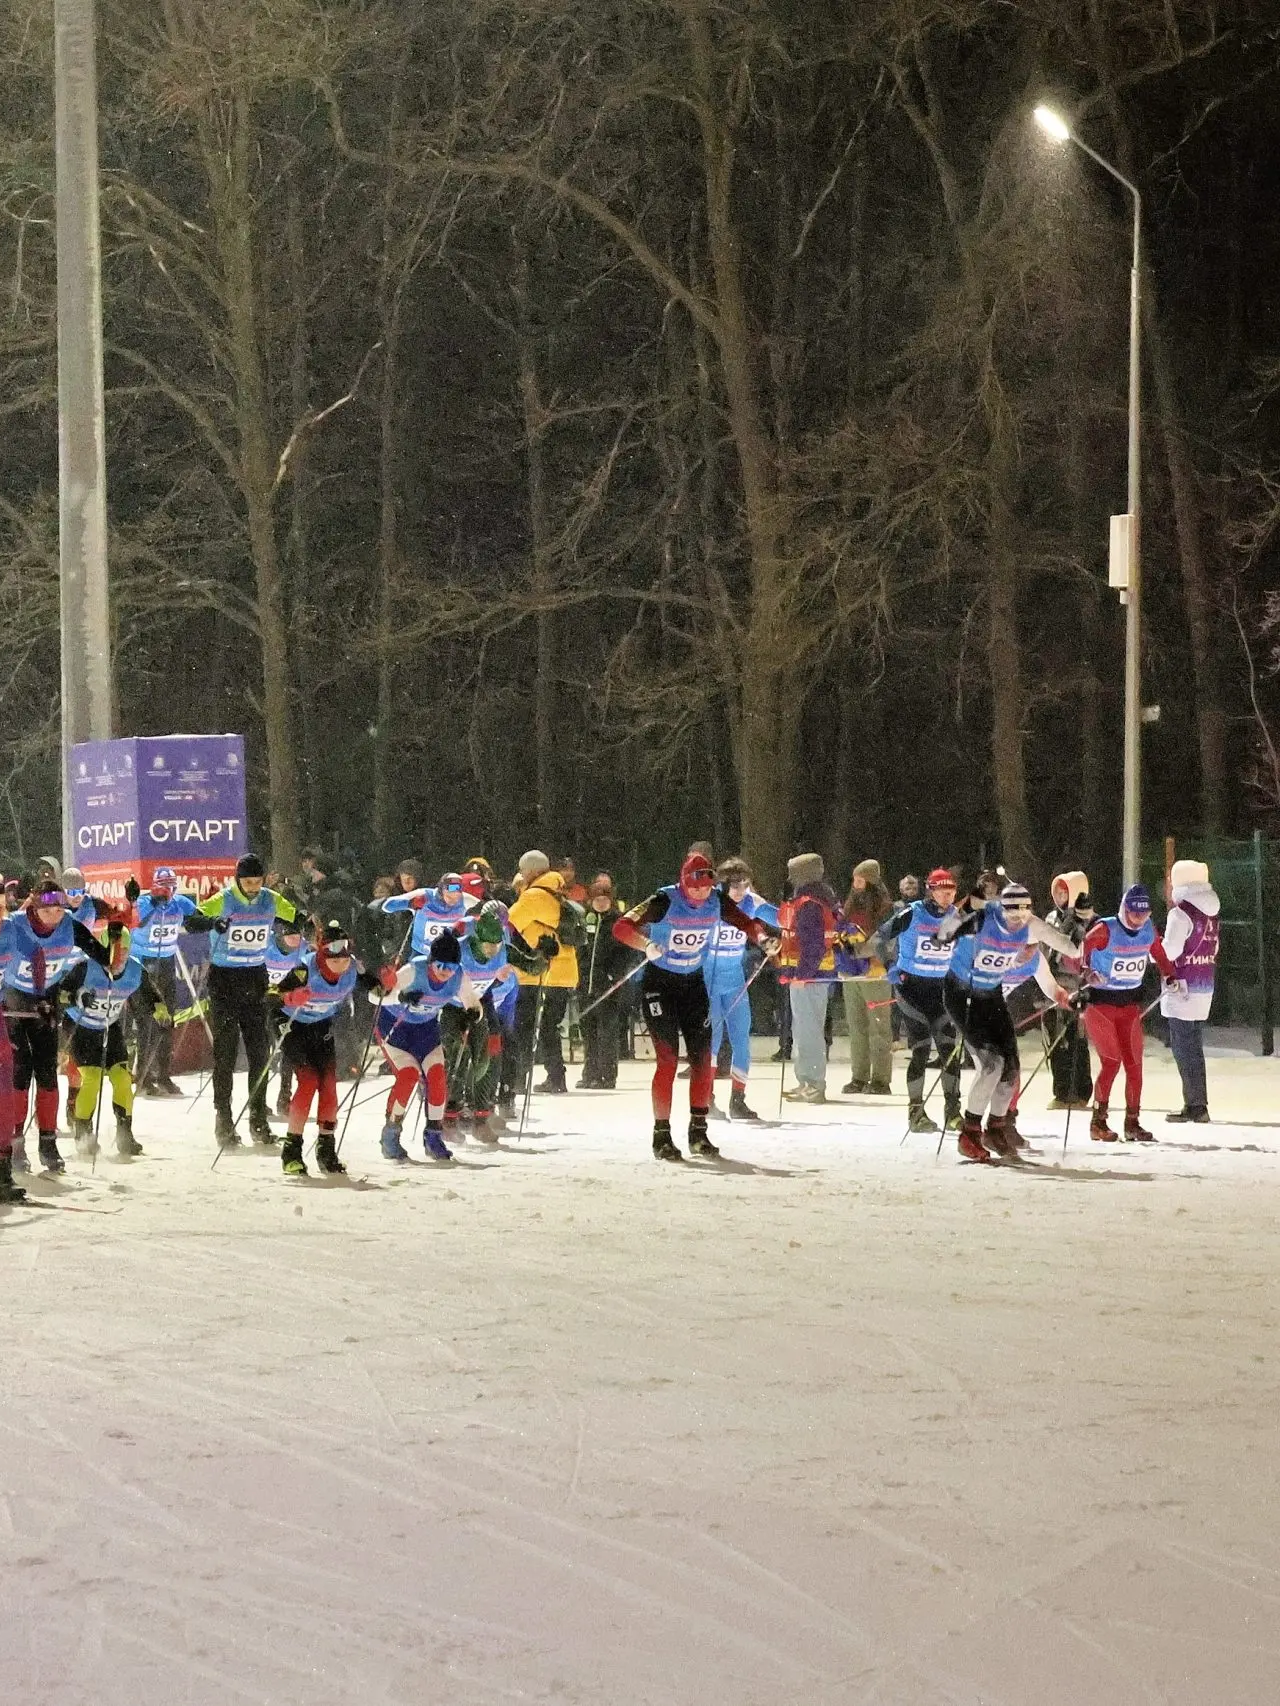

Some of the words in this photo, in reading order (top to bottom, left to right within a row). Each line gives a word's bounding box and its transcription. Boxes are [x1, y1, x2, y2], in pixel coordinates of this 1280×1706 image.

[78, 821, 135, 848] СТАРТ
[149, 819, 239, 842] СТАРТ
[231, 928, 267, 942] 606
[673, 933, 706, 946] 605
[719, 930, 743, 940] 616
[1114, 959, 1145, 972] 600
